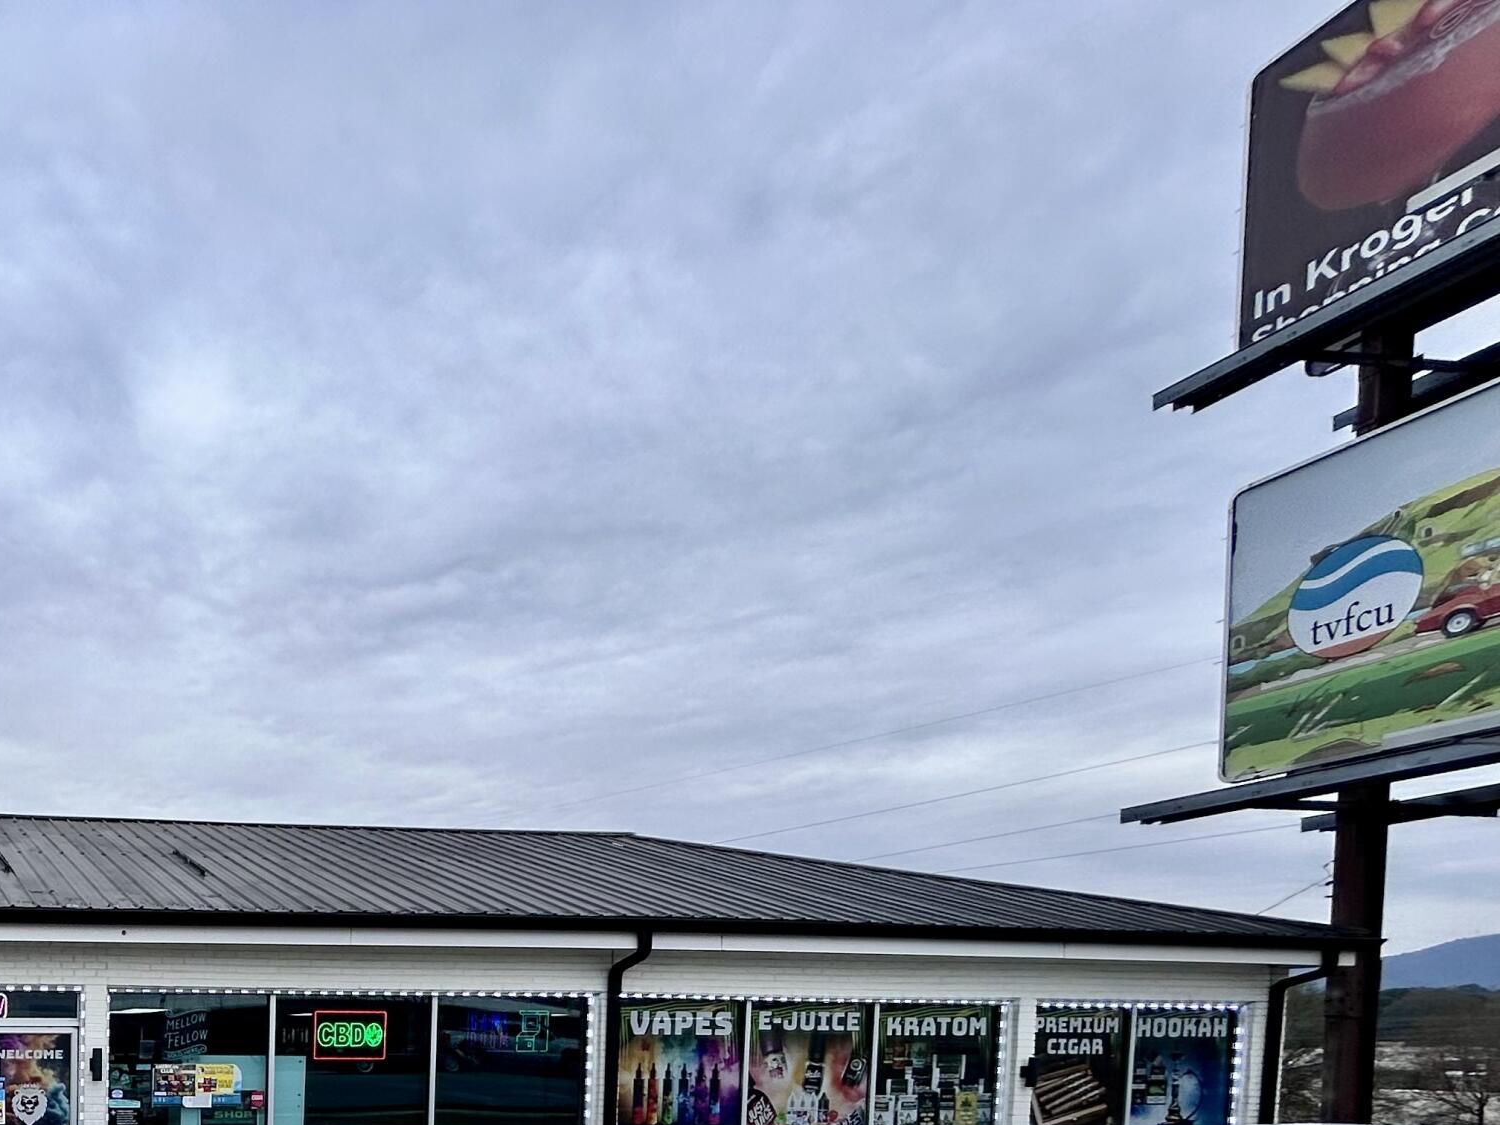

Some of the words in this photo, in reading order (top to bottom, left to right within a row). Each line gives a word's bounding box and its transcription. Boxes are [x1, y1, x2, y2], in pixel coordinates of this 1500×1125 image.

[1253, 282, 1291, 320] In
[1310, 601, 1395, 645] tvfcu
[166, 1012, 206, 1031] MELLOW
[630, 1011, 733, 1036] VAPES
[758, 1011, 861, 1032] E-JUICE
[887, 1016, 987, 1036] KRATOM
[1035, 1016, 1120, 1034] PREMIUM
[1136, 1017, 1228, 1038] HOOKAH
[164, 1029, 208, 1049] FELLOW
[317, 1022, 366, 1047] CBD
[1046, 1038, 1104, 1055] CIGAR
